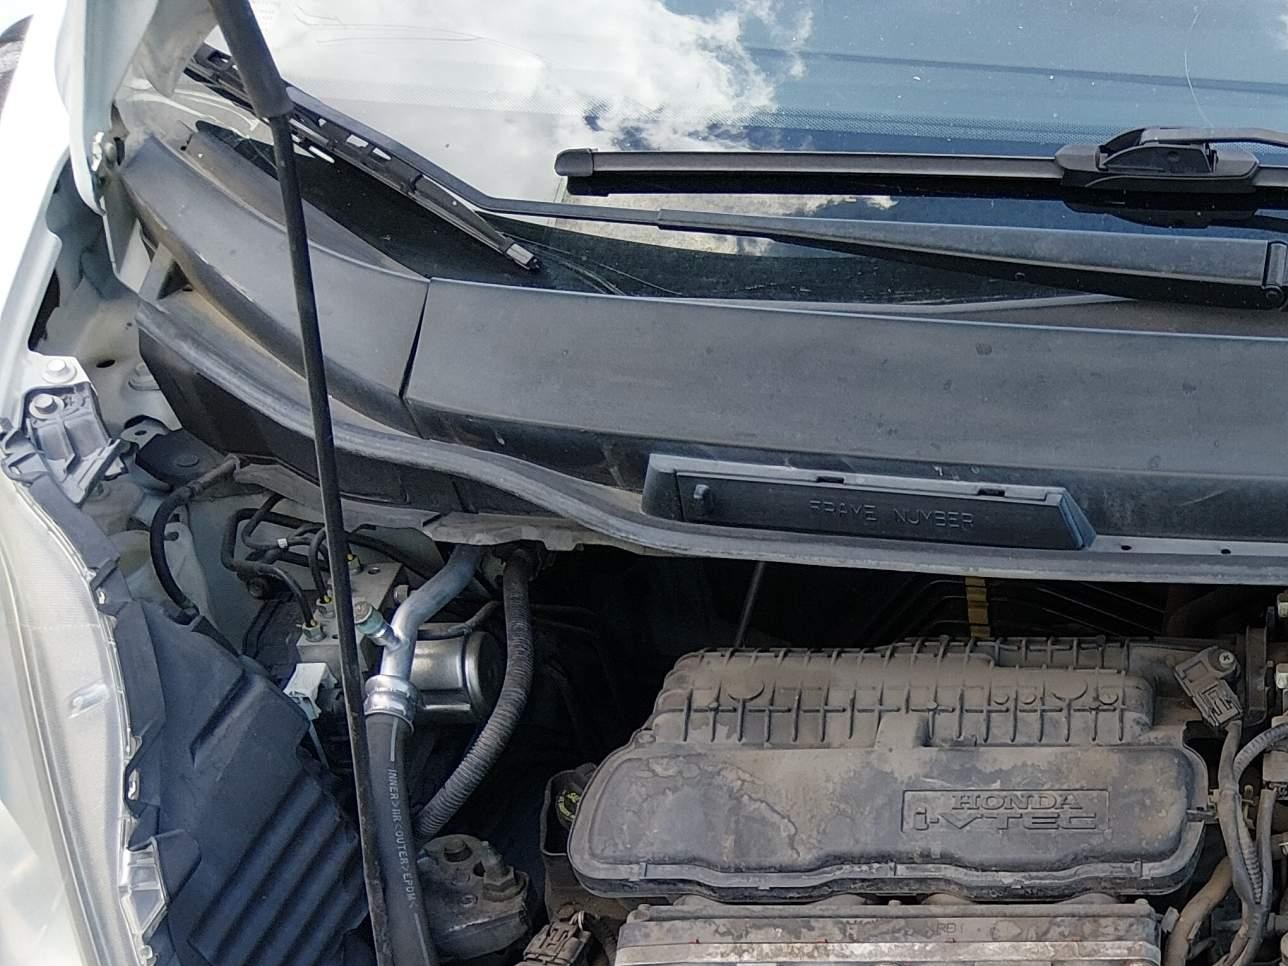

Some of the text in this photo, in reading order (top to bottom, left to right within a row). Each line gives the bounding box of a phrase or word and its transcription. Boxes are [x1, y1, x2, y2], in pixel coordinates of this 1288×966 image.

[809, 500, 976, 531] FRAME NUMBER
[952, 794, 1084, 811] HONDA
[913, 807, 1097, 831] i-VTEC
